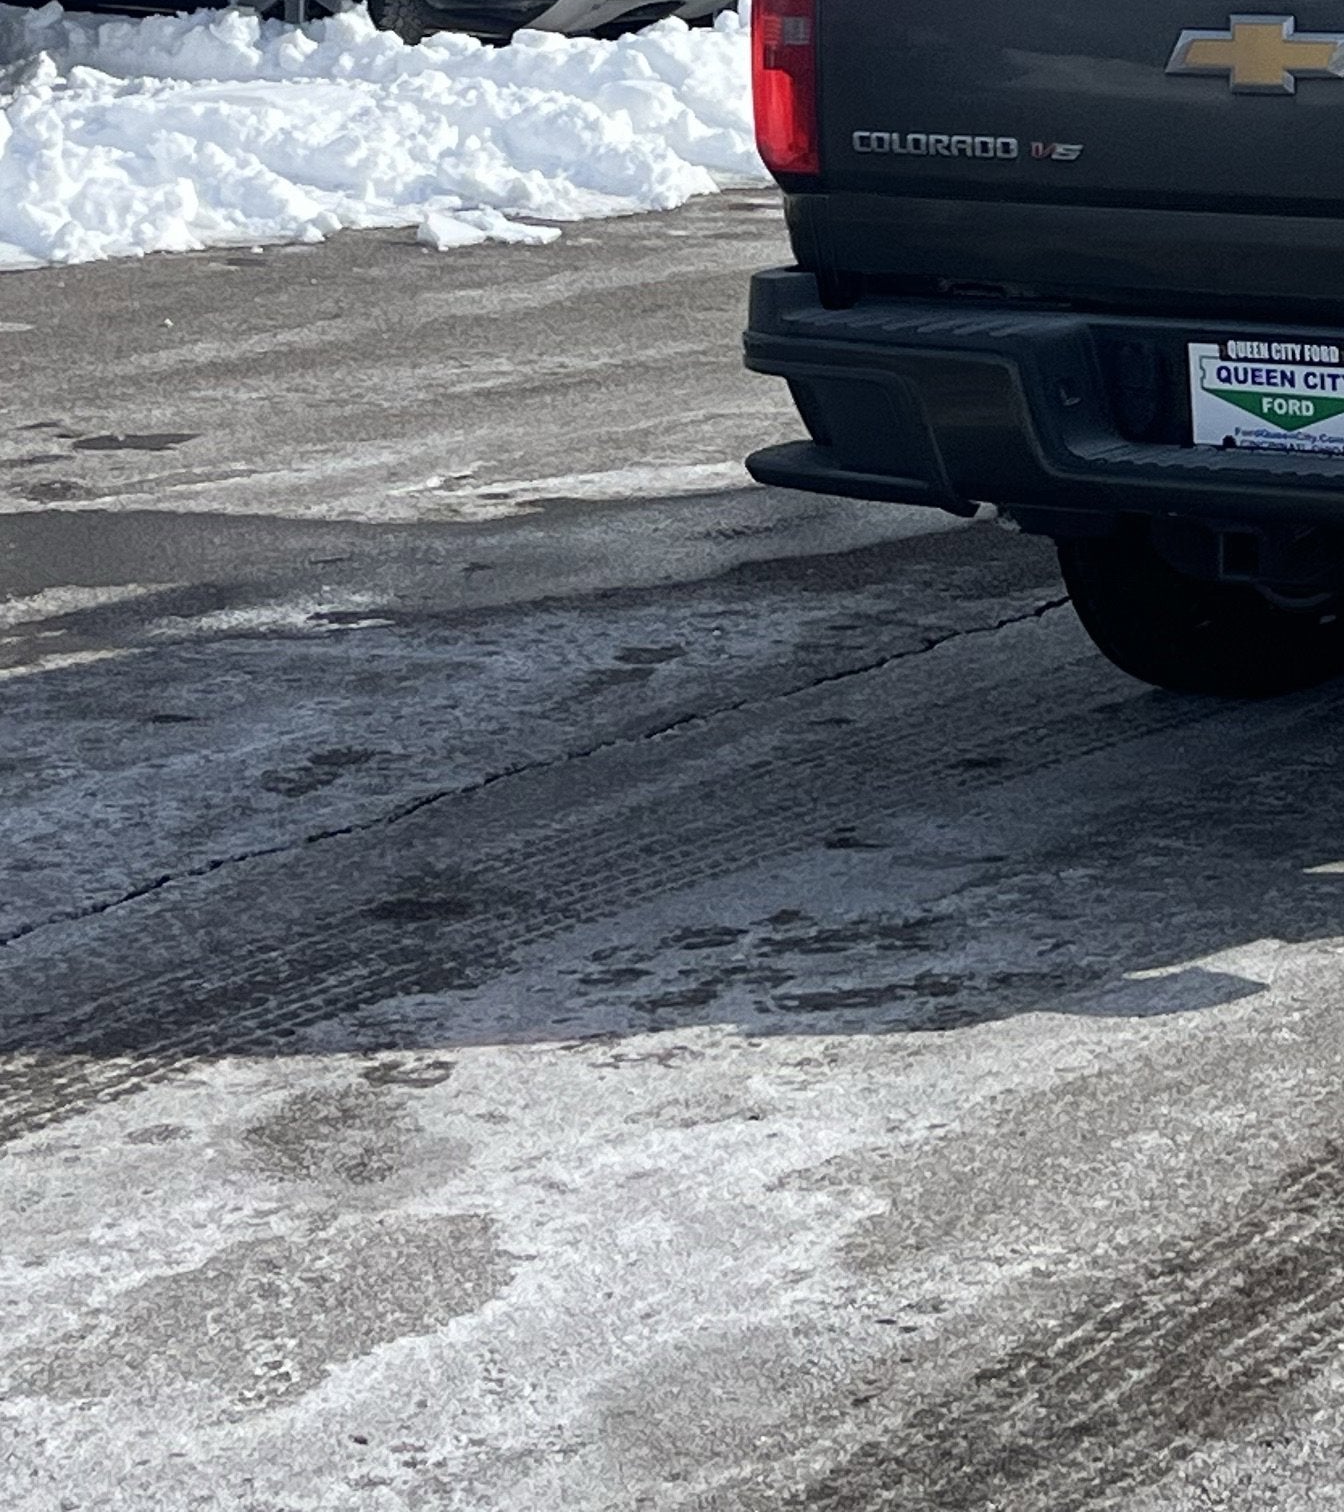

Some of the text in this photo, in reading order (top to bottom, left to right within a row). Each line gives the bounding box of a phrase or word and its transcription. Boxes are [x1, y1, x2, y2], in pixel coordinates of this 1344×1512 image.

[852, 130, 1019, 160] COLORADO
[1227, 340, 1340, 363] QUEEN CITY FORD
[1216, 365, 1296, 389] QUEEN
[1261, 397, 1315, 417] FORD
